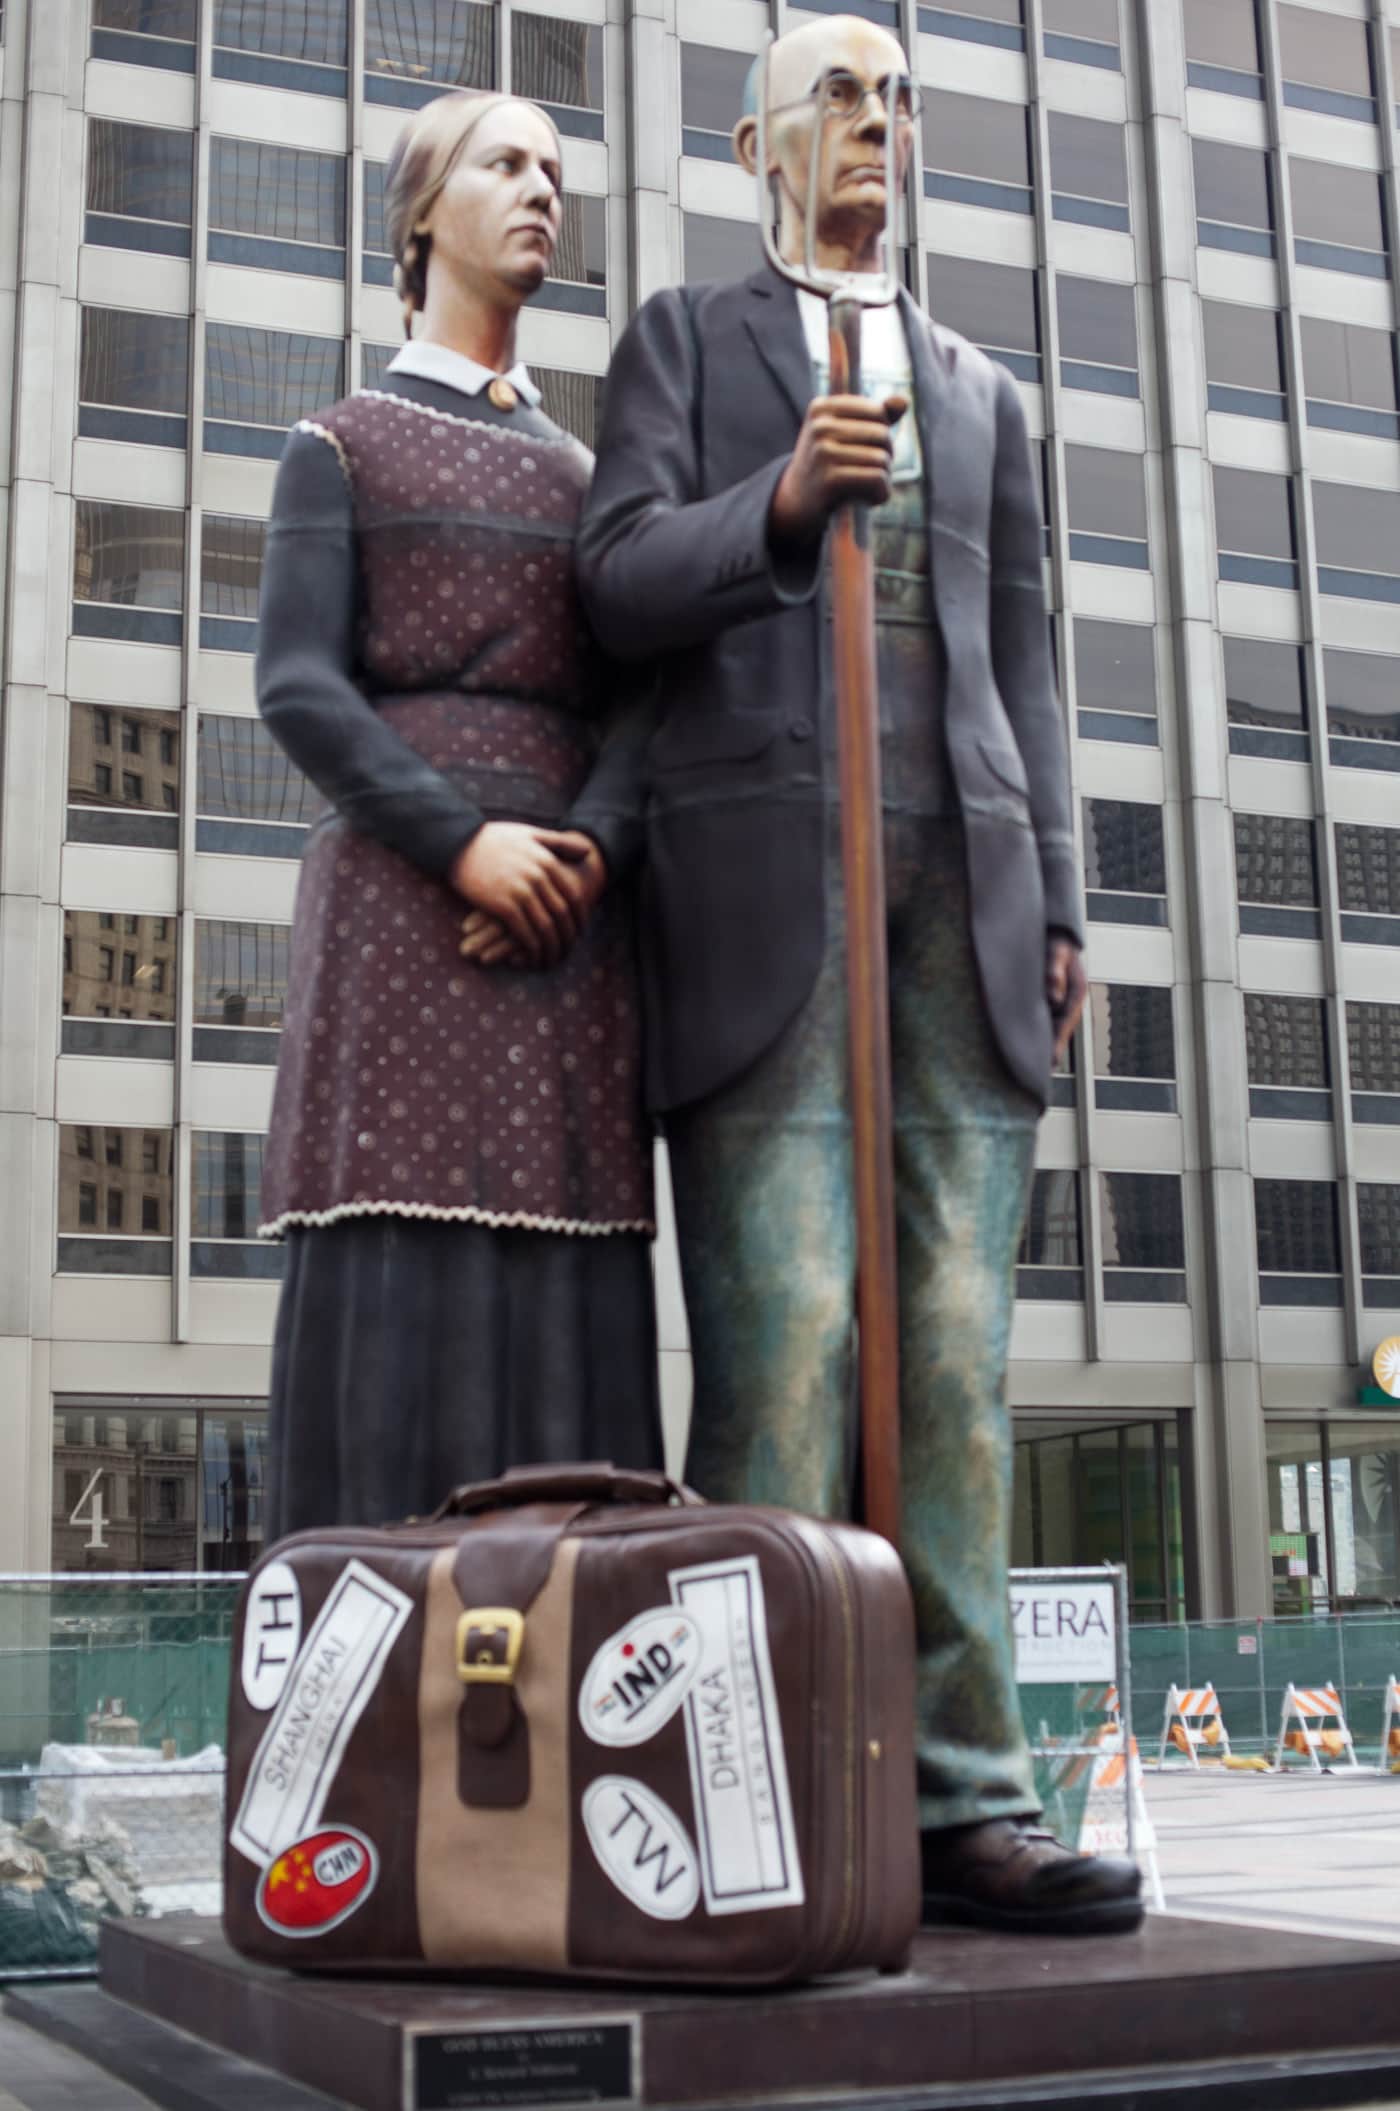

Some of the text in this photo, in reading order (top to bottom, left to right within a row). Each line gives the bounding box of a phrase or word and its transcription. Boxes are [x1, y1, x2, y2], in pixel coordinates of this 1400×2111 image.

[69, 1467, 110, 1548] 4
[255, 1593, 294, 1681] TH
[611, 1642, 674, 1708] IND
[264, 1635, 349, 1792] SHANGHAI
[701, 1666, 741, 1791] DHAKA
[608, 1791, 687, 1895] TW
